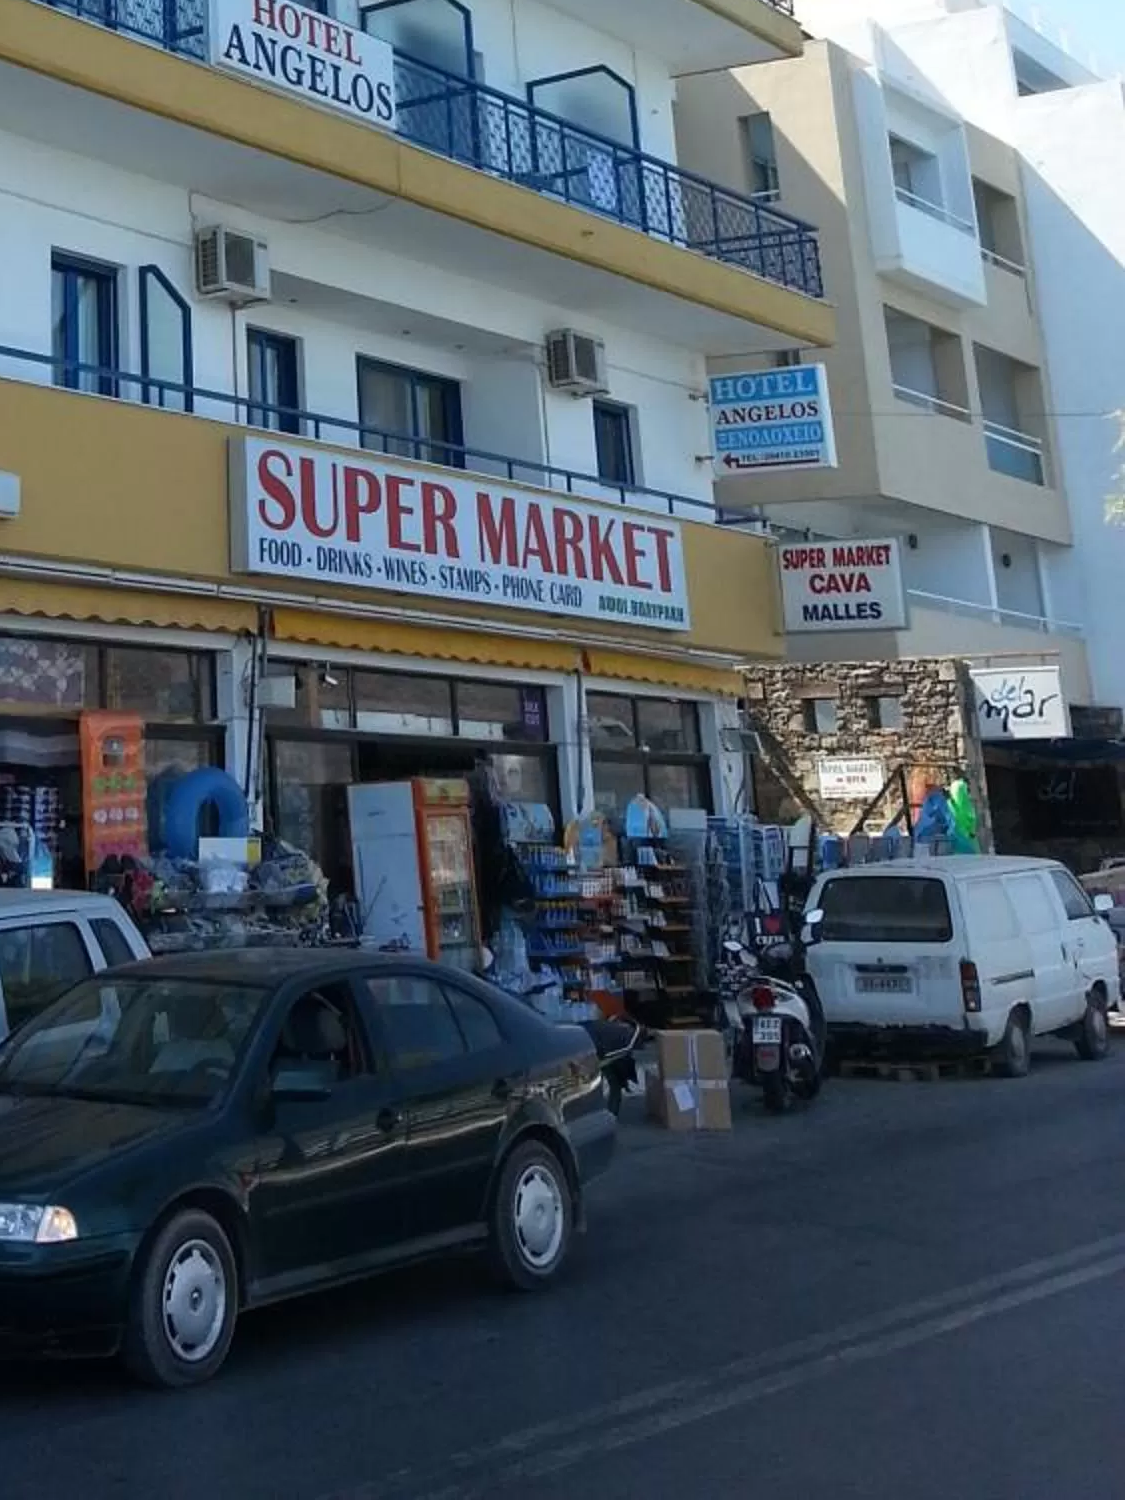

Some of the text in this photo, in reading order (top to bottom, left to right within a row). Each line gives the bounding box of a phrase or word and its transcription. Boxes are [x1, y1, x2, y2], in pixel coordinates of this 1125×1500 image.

[224, 23, 393, 122] ANGELOS
[714, 372, 813, 400] HOTEL
[717, 400, 819, 426] ANGELOS
[257, 449, 674, 594] SUPER MARKET
[783, 544, 892, 570] SUPER MARKET
[259, 537, 583, 609] FOOD DRINKS WINES STAMPS PHONE CARD
[809, 573, 872, 595] CAVA
[802, 601, 883, 622] MALLES
[990, 675, 1026, 703] del
[978, 689, 1060, 733] mar
